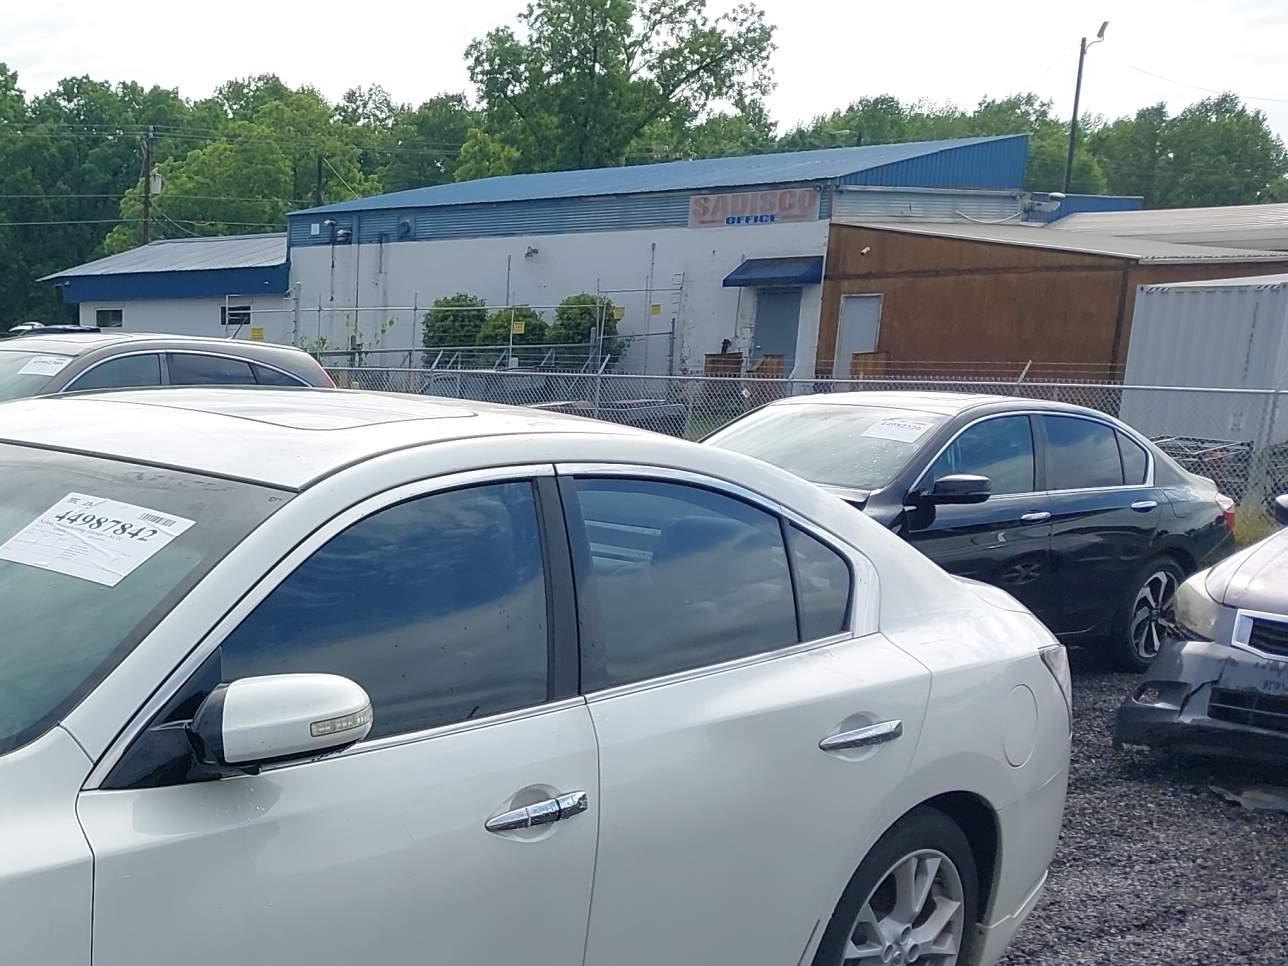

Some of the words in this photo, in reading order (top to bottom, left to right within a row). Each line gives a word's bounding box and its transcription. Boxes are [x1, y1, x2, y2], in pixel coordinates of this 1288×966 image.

[694, 190, 817, 217] SADISCO
[725, 214, 776, 225] OFFICE
[55, 510, 158, 541] 44987842
